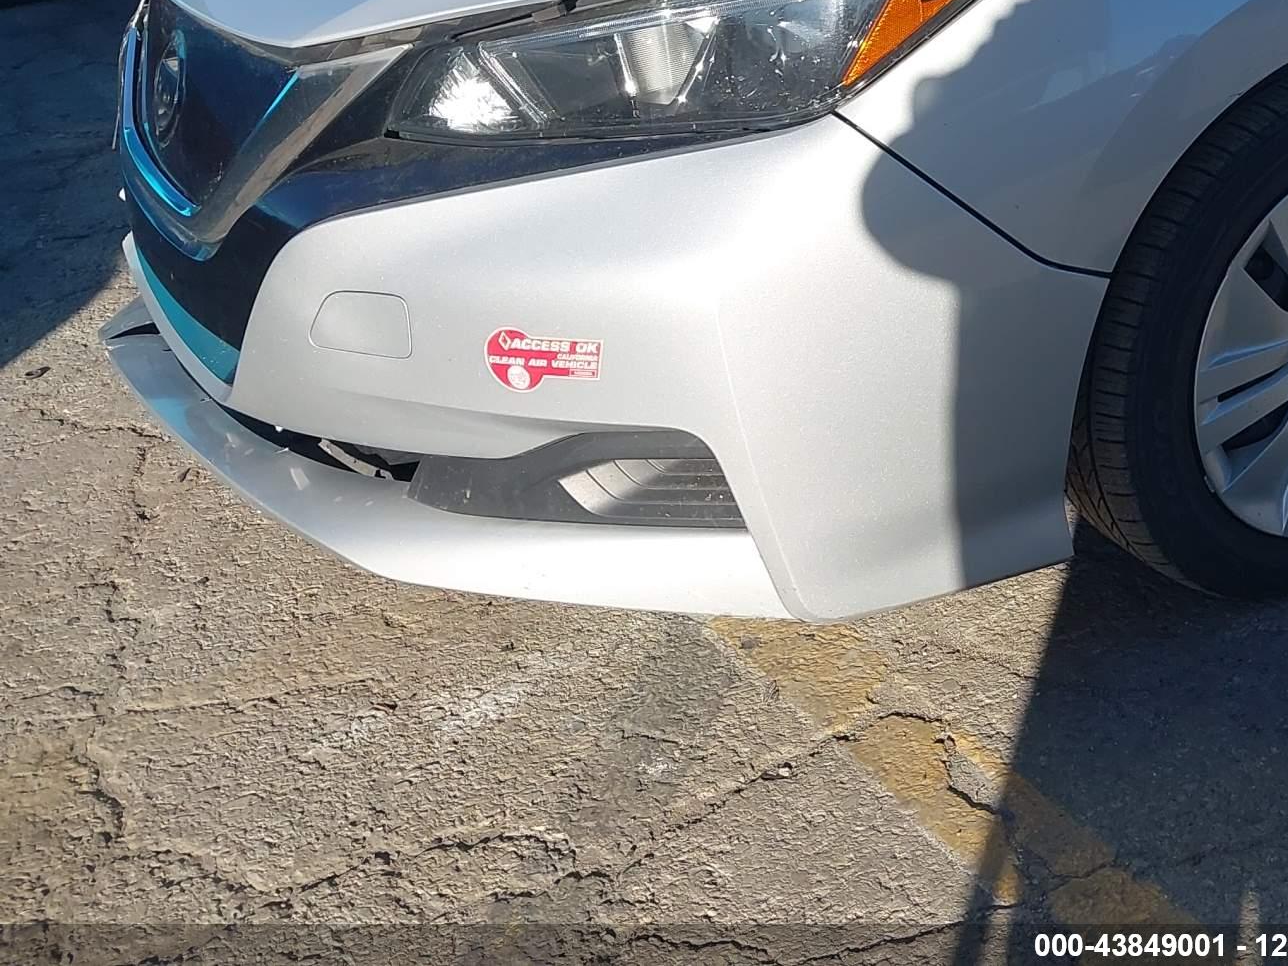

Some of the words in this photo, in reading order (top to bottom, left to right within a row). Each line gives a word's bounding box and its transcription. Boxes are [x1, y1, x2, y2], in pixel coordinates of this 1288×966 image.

[510, 338, 571, 353] ACCESS
[575, 341, 599, 354] OK
[488, 355, 526, 367] CLEAN
[528, 358, 548, 368] AIR
[551, 359, 598, 370] VEHICLE
